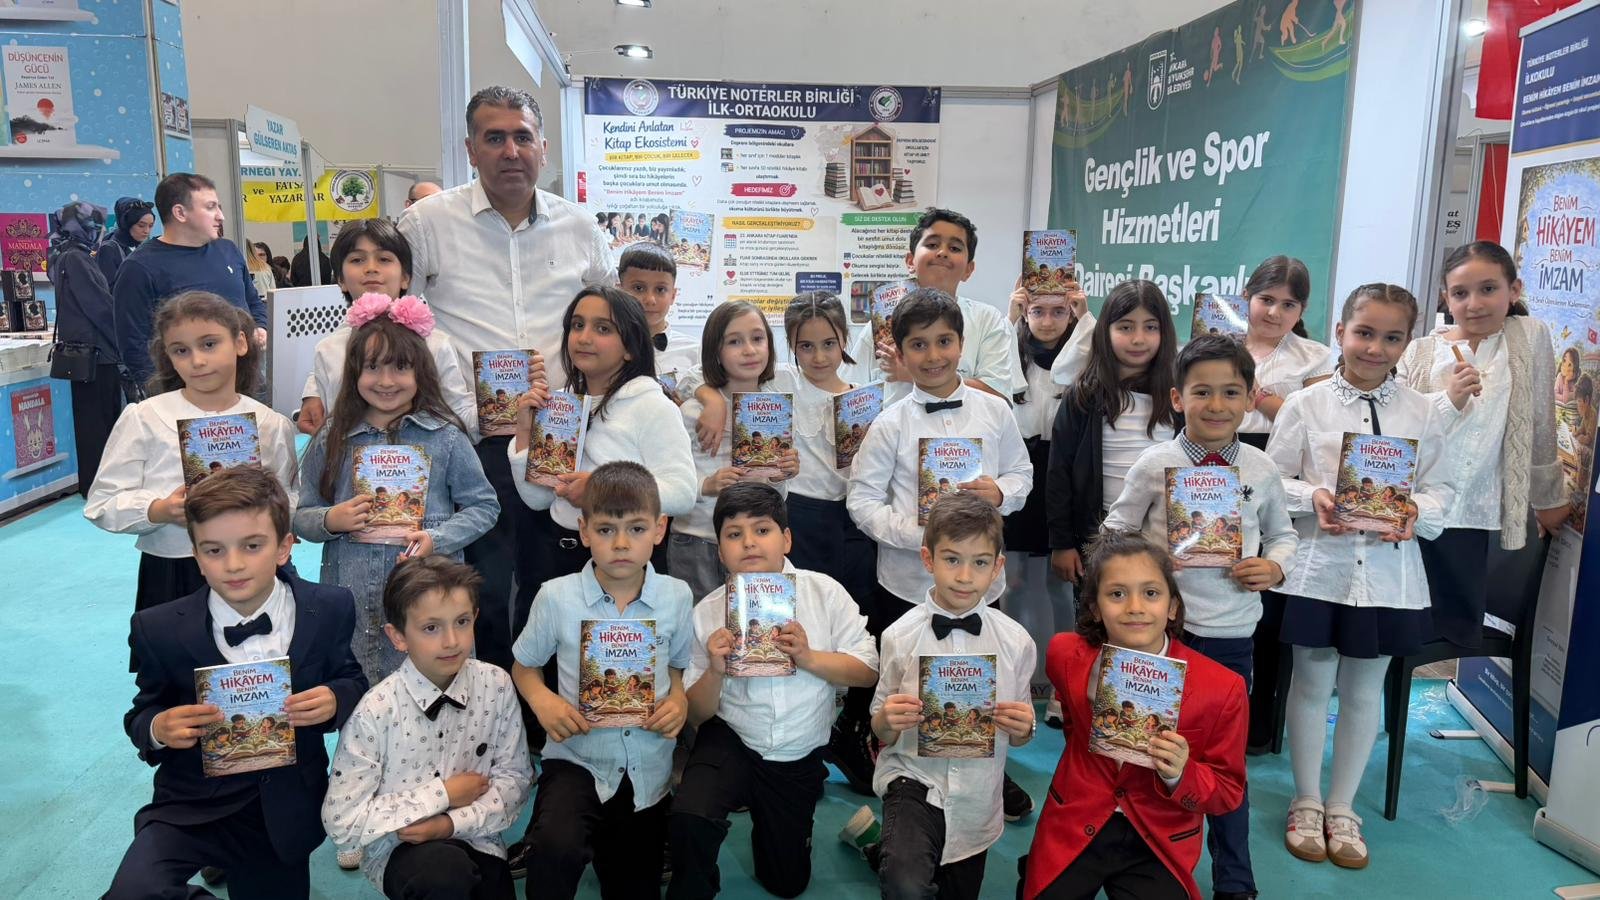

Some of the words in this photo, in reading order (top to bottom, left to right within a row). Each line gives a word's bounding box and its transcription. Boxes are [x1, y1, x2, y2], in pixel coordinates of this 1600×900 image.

[8, 52, 63, 63] DÜŞÜNCENİN
[24, 64, 49, 74] GÜCÜ
[1524, 66, 1556, 85] İLKOKULU
[668, 84, 728, 100] TÜRKİYE
[730, 87, 802, 103] NOTERLER
[807, 88, 854, 104] BİRLİĞİ
[1522, 91, 1539, 104] BENİM
[1562, 78, 1580, 93] BENİM
[708, 101, 817, 118] İLK-ORTAOKULU
[266, 119, 284, 136] YAZAR
[603, 121, 636, 134] Kendini
[638, 120, 674, 133] Anlatan
[253, 129, 282, 151] GÜLSEREN
[282, 140, 298, 158] AKTAŞ
[605, 137, 632, 152] Kitap
[635, 136, 687, 149] Ekosistemi
[1084, 146, 1164, 198] Gençlik
[1167, 148, 1196, 182] ve
[1203, 131, 1270, 185] Spor
[240, 167, 275, 177] RNEGI
[279, 167, 301, 177] YAY.
[269, 192, 325, 203] YAZARAR
[1553, 195, 1578, 212] BENİM
[1101, 197, 1222, 245] Hizmetleri
[1446, 220, 1461, 229] EŞ
[1537, 214, 1596, 247] HİKÂYEM
[8, 242, 43, 250] MANDALA
[1036, 238, 1067, 246] HİKÂYEM
[1550, 249, 1573, 263] BENİM
[1538, 263, 1584, 294] İMZAM
[488, 359, 525, 369] HİKÂYEM
[495, 372, 521, 380] İMZAM
[18, 397, 45, 412] MANDALA
[747, 401, 782, 411] HİKÂYEM
[846, 393, 875, 408] HİKÂYEM
[546, 400, 575, 413] HİKÂYEM
[851, 405, 872, 416] İMZAM
[548, 417, 569, 426] İMZAM
[752, 415, 778, 423] İMZAM
[198, 425, 244, 439] HİKÂYEM
[207, 441, 241, 452] İMZAM
[934, 447, 970, 457] HİKÂYEM
[1360, 444, 1403, 458] HİKÂYEM
[370, 454, 411, 465] HİKÂYEM
[939, 461, 967, 469] İMZAM
[1364, 459, 1396, 471] İMZAM
[376, 469, 407, 477] İMZAM
[1183, 477, 1227, 488] HİKÂYEM
[1190, 492, 1223, 501] İMZAM
[599, 631, 643, 643] HİKÂYEM
[605, 648, 637, 657] İMZAM
[1133, 656, 1155, 666] BENİM
[233, 668, 257, 676] BENİM
[938, 666, 982, 678] HİKÂYEM
[1121, 661, 1168, 682] HİKÂYEM
[220, 673, 274, 690] HİKÂYEM
[1133, 676, 1152, 684] BENİM
[236, 686, 258, 694] BENİM
[944, 682, 977, 692] İMZAM
[1125, 679, 1160, 696] İMZAM
[229, 691, 269, 703] İMZAM
